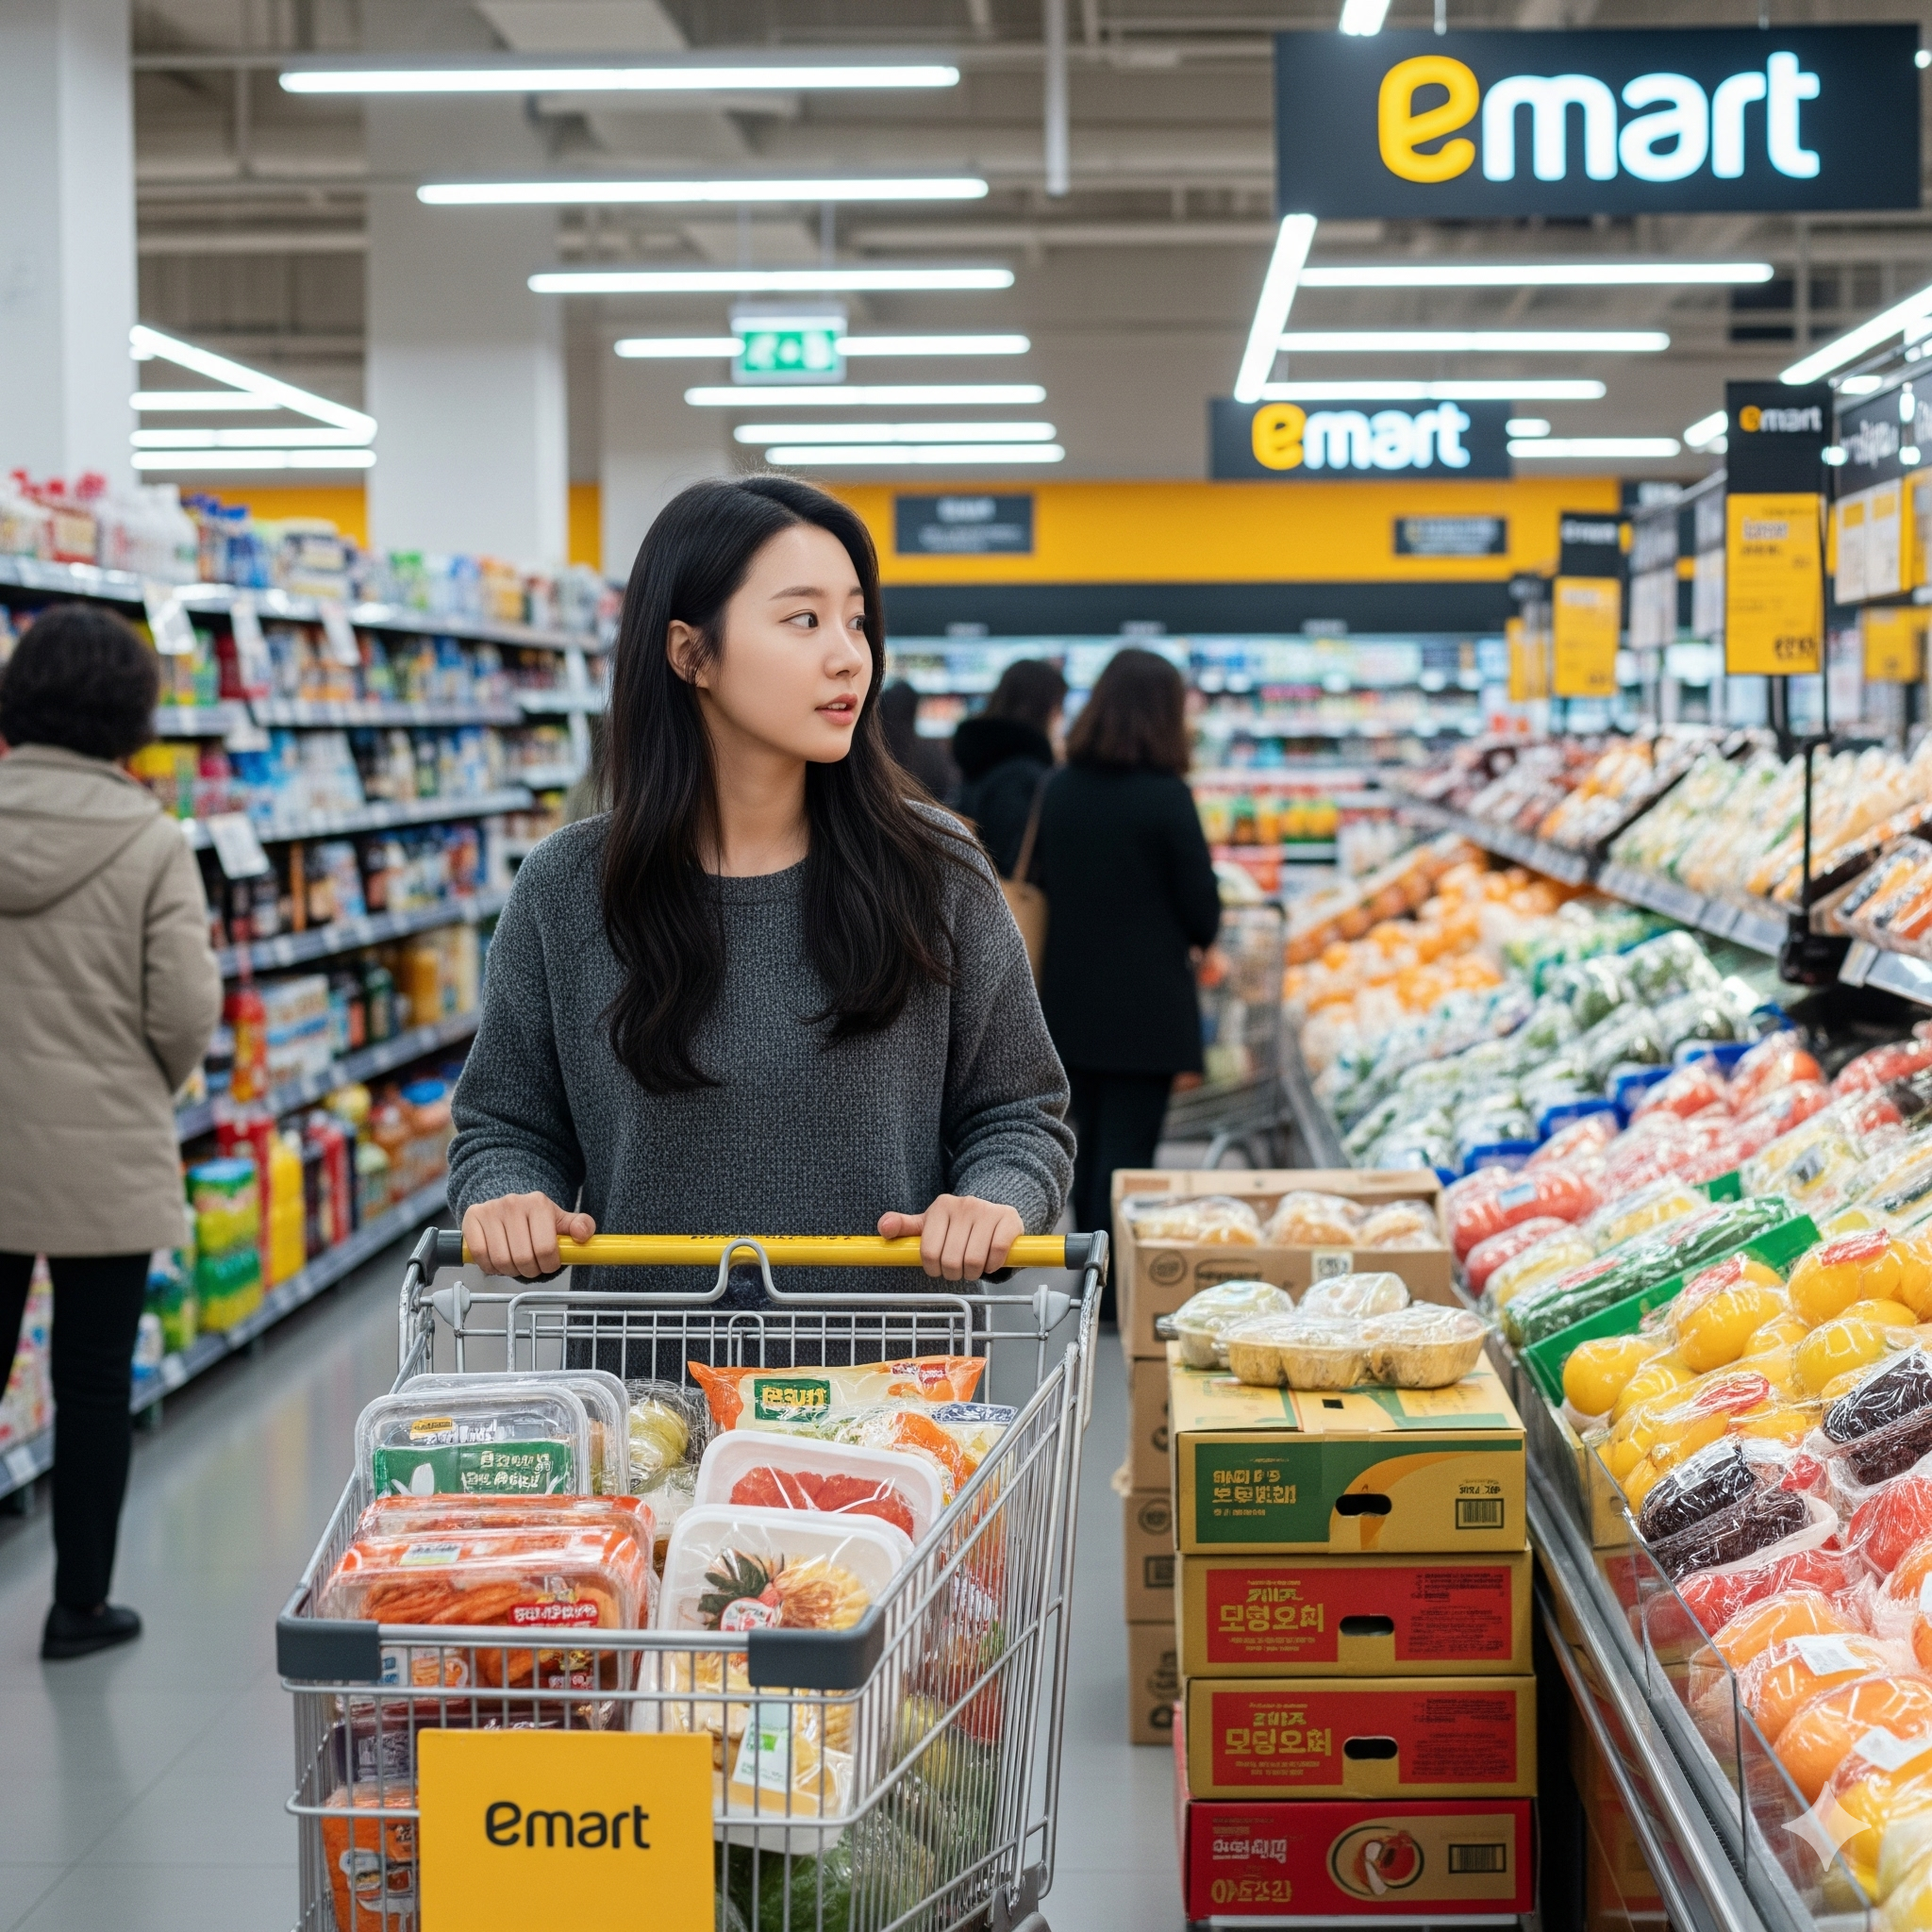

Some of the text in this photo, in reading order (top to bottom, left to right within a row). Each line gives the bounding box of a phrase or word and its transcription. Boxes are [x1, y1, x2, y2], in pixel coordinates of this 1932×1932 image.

[1378, 51, 1821, 183] emart
[1251, 402, 1471, 471] emart
[485, 1801, 650, 1850] emart
